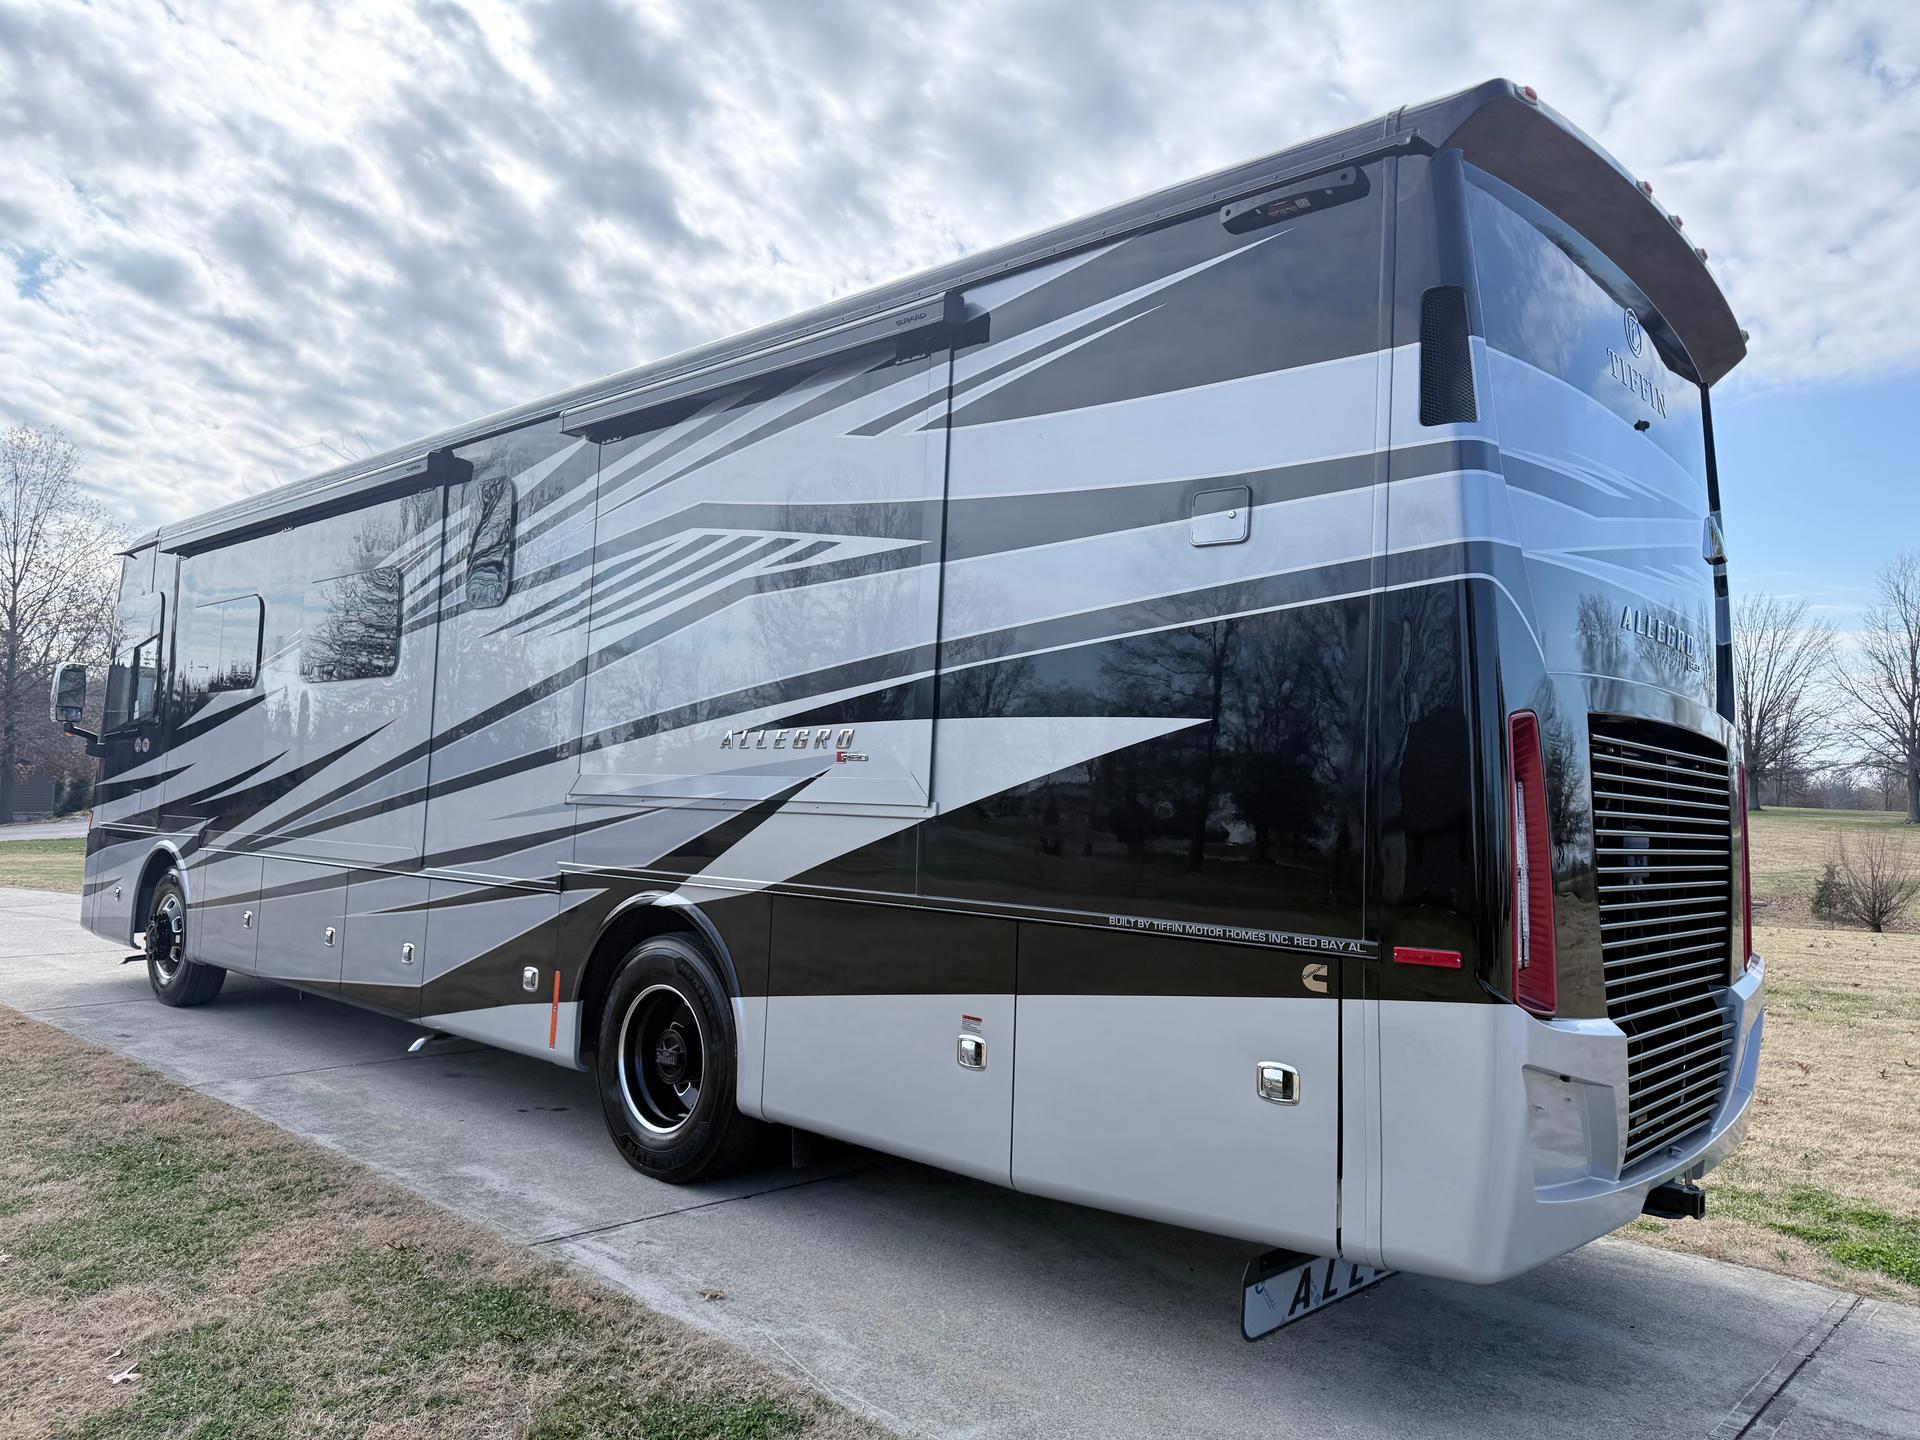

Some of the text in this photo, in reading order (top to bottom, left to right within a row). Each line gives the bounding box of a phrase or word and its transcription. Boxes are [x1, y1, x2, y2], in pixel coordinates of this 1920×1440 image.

[1606, 347, 1667, 419] TIFFIN
[1621, 605, 1694, 657] ALLEGRO
[720, 728, 856, 750] ALLEGRO
[1109, 917, 1367, 953] BUILT BY TIFFIN MOTOR HOMES INC. RED BAY AL.
[1288, 1258, 1387, 1316] ALL
